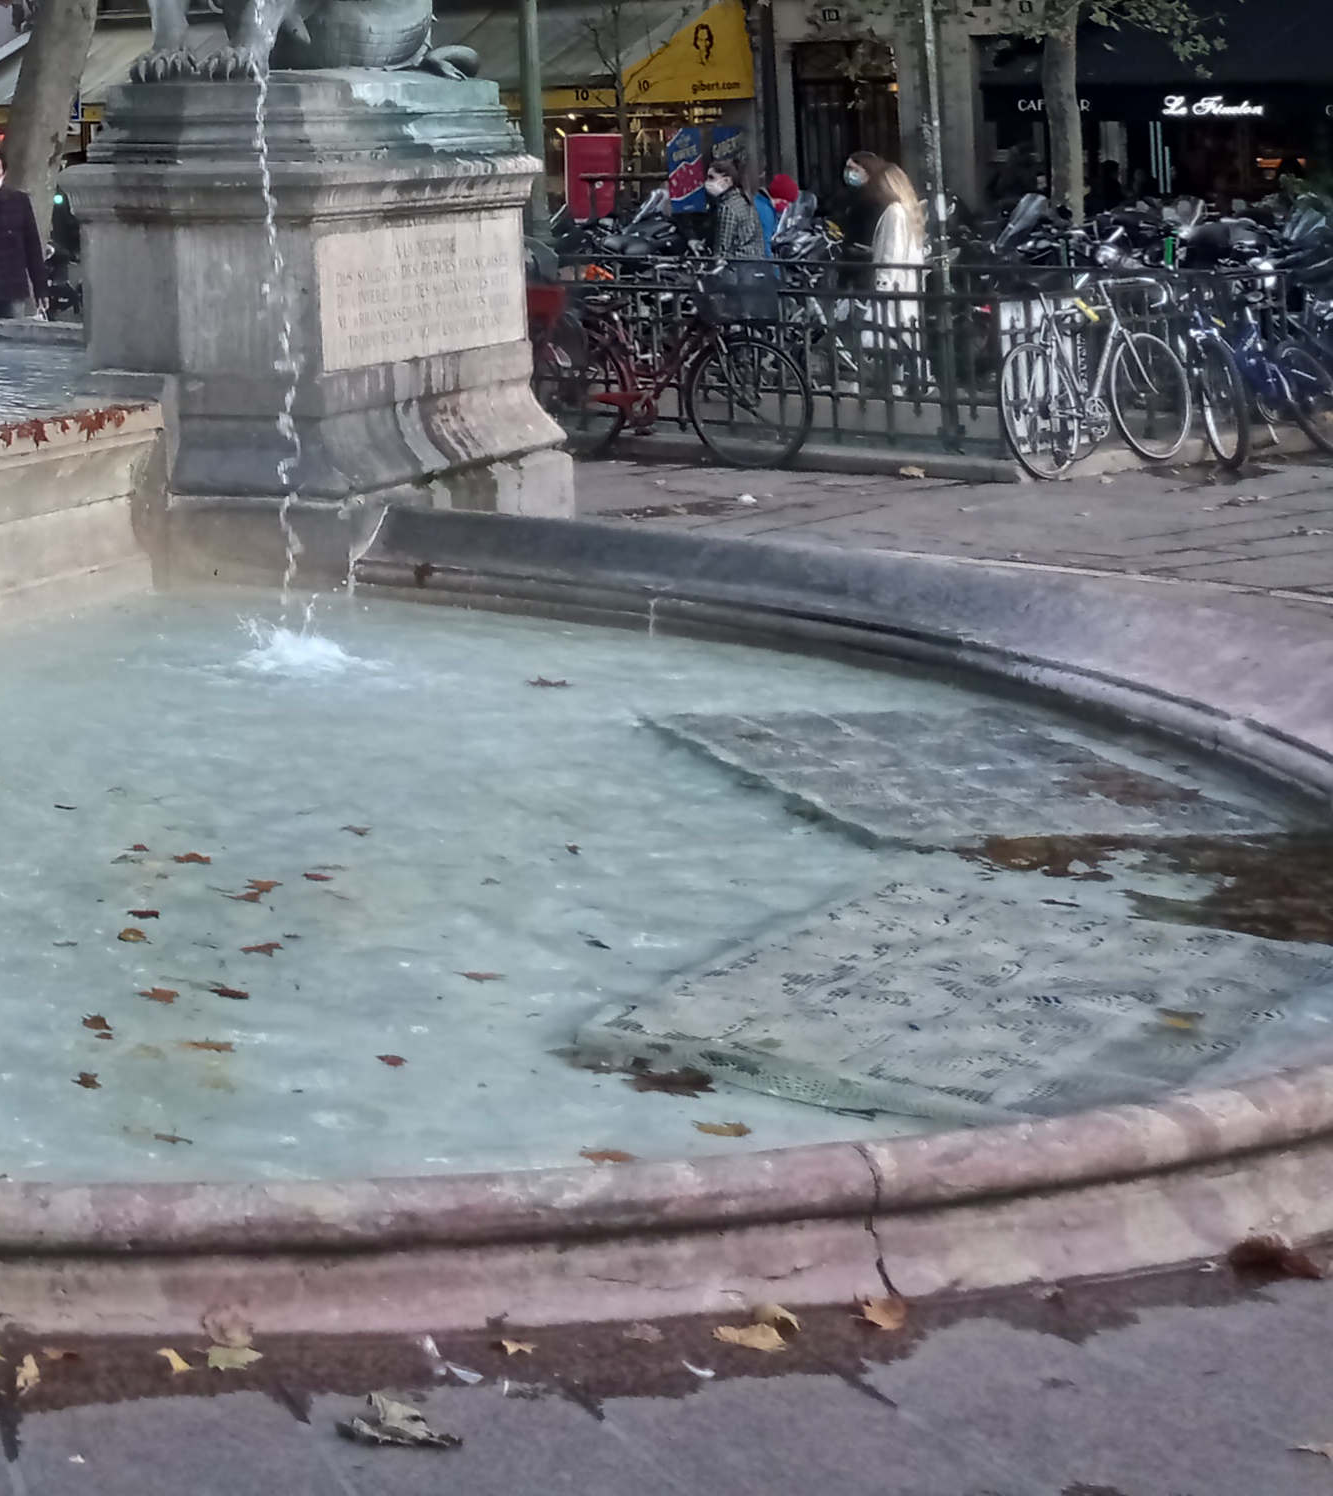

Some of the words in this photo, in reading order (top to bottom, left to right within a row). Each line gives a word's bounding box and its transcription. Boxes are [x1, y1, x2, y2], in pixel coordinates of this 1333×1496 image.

[637, 80, 650, 92] 10
[691, 80, 741, 94] gibert.com
[574, 90, 589, 102] 10
[1017, 99, 1045, 112] CAF
[1162, 95, 1188, 115] Le
